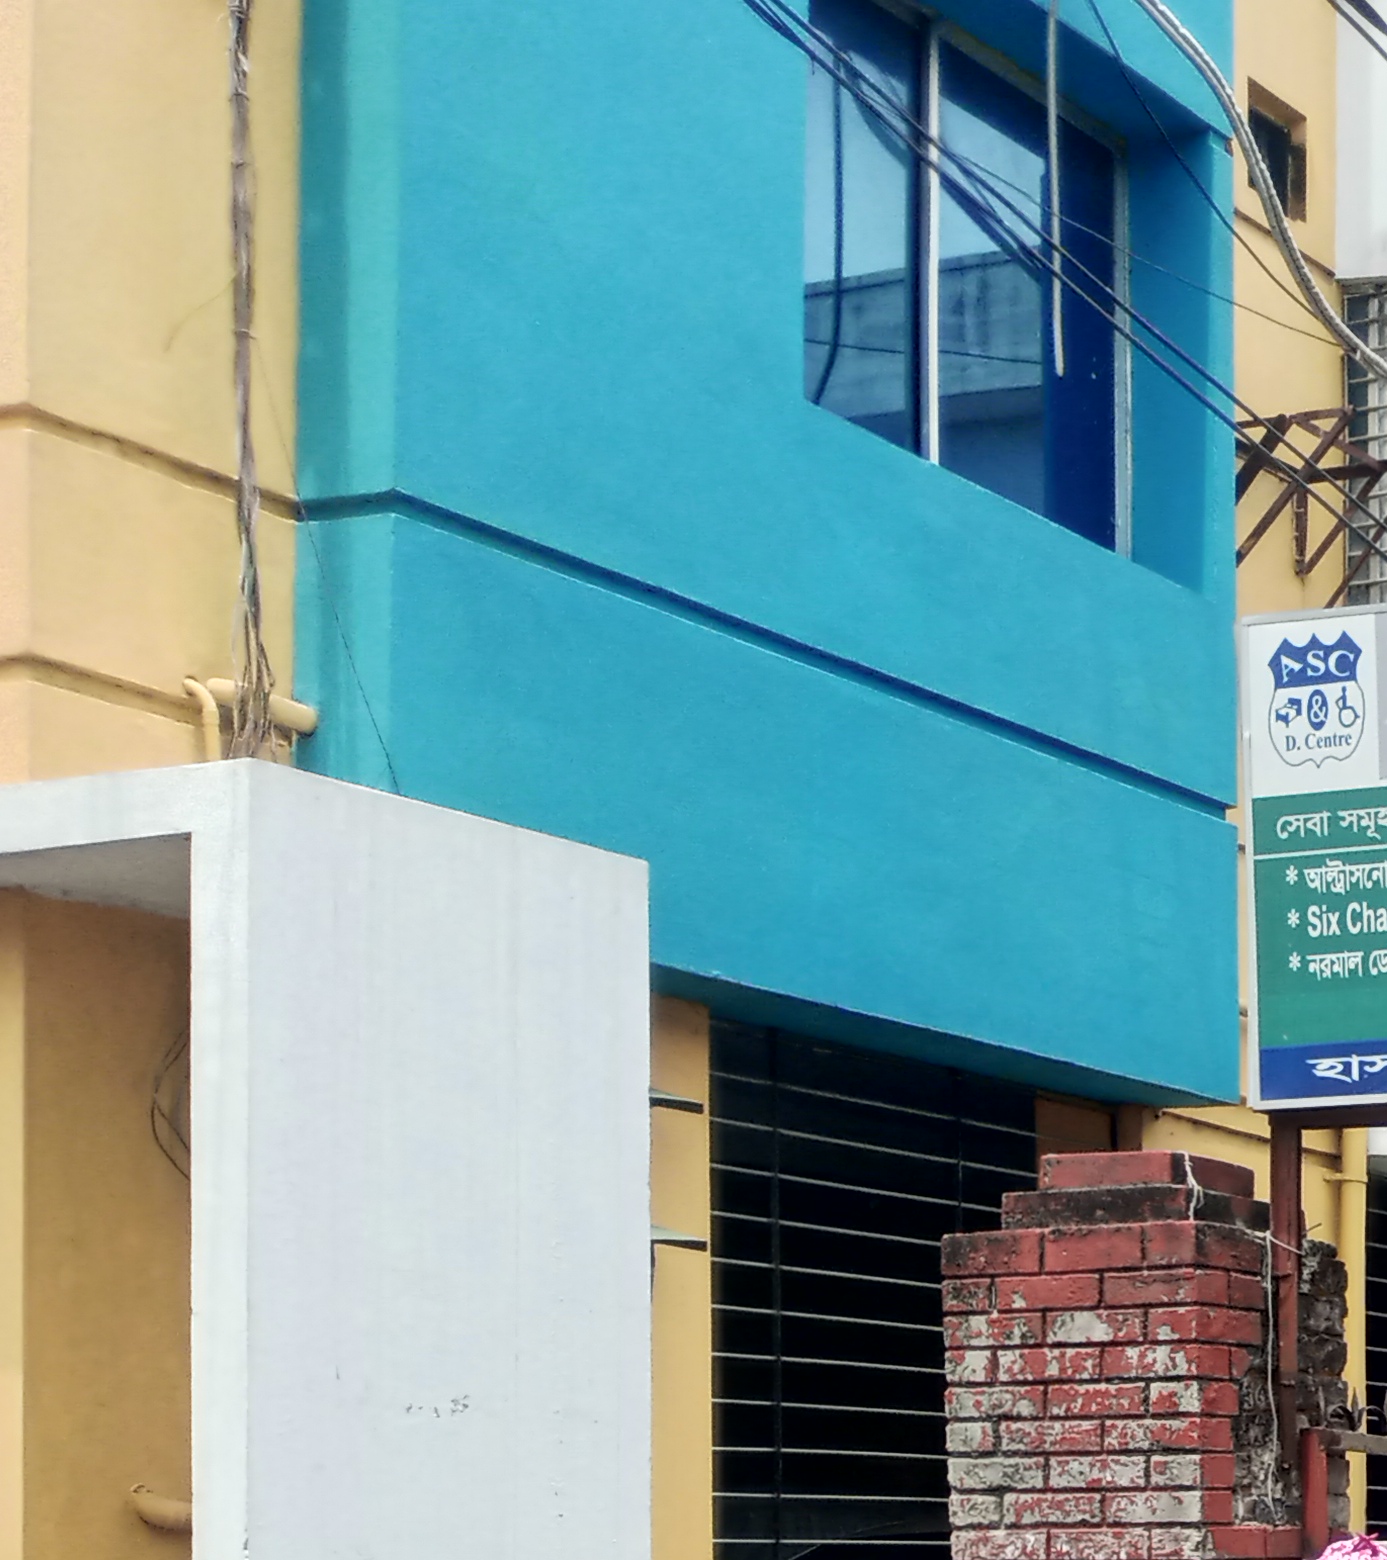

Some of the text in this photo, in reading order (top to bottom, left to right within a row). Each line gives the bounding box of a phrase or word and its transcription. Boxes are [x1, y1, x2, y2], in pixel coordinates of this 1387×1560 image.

[1279, 648, 1356, 684] ASC
[1285, 731, 1352, 751] D. Centre
[1276, 810, 1332, 840] সেবা
[1307, 904, 1341, 937] Six
